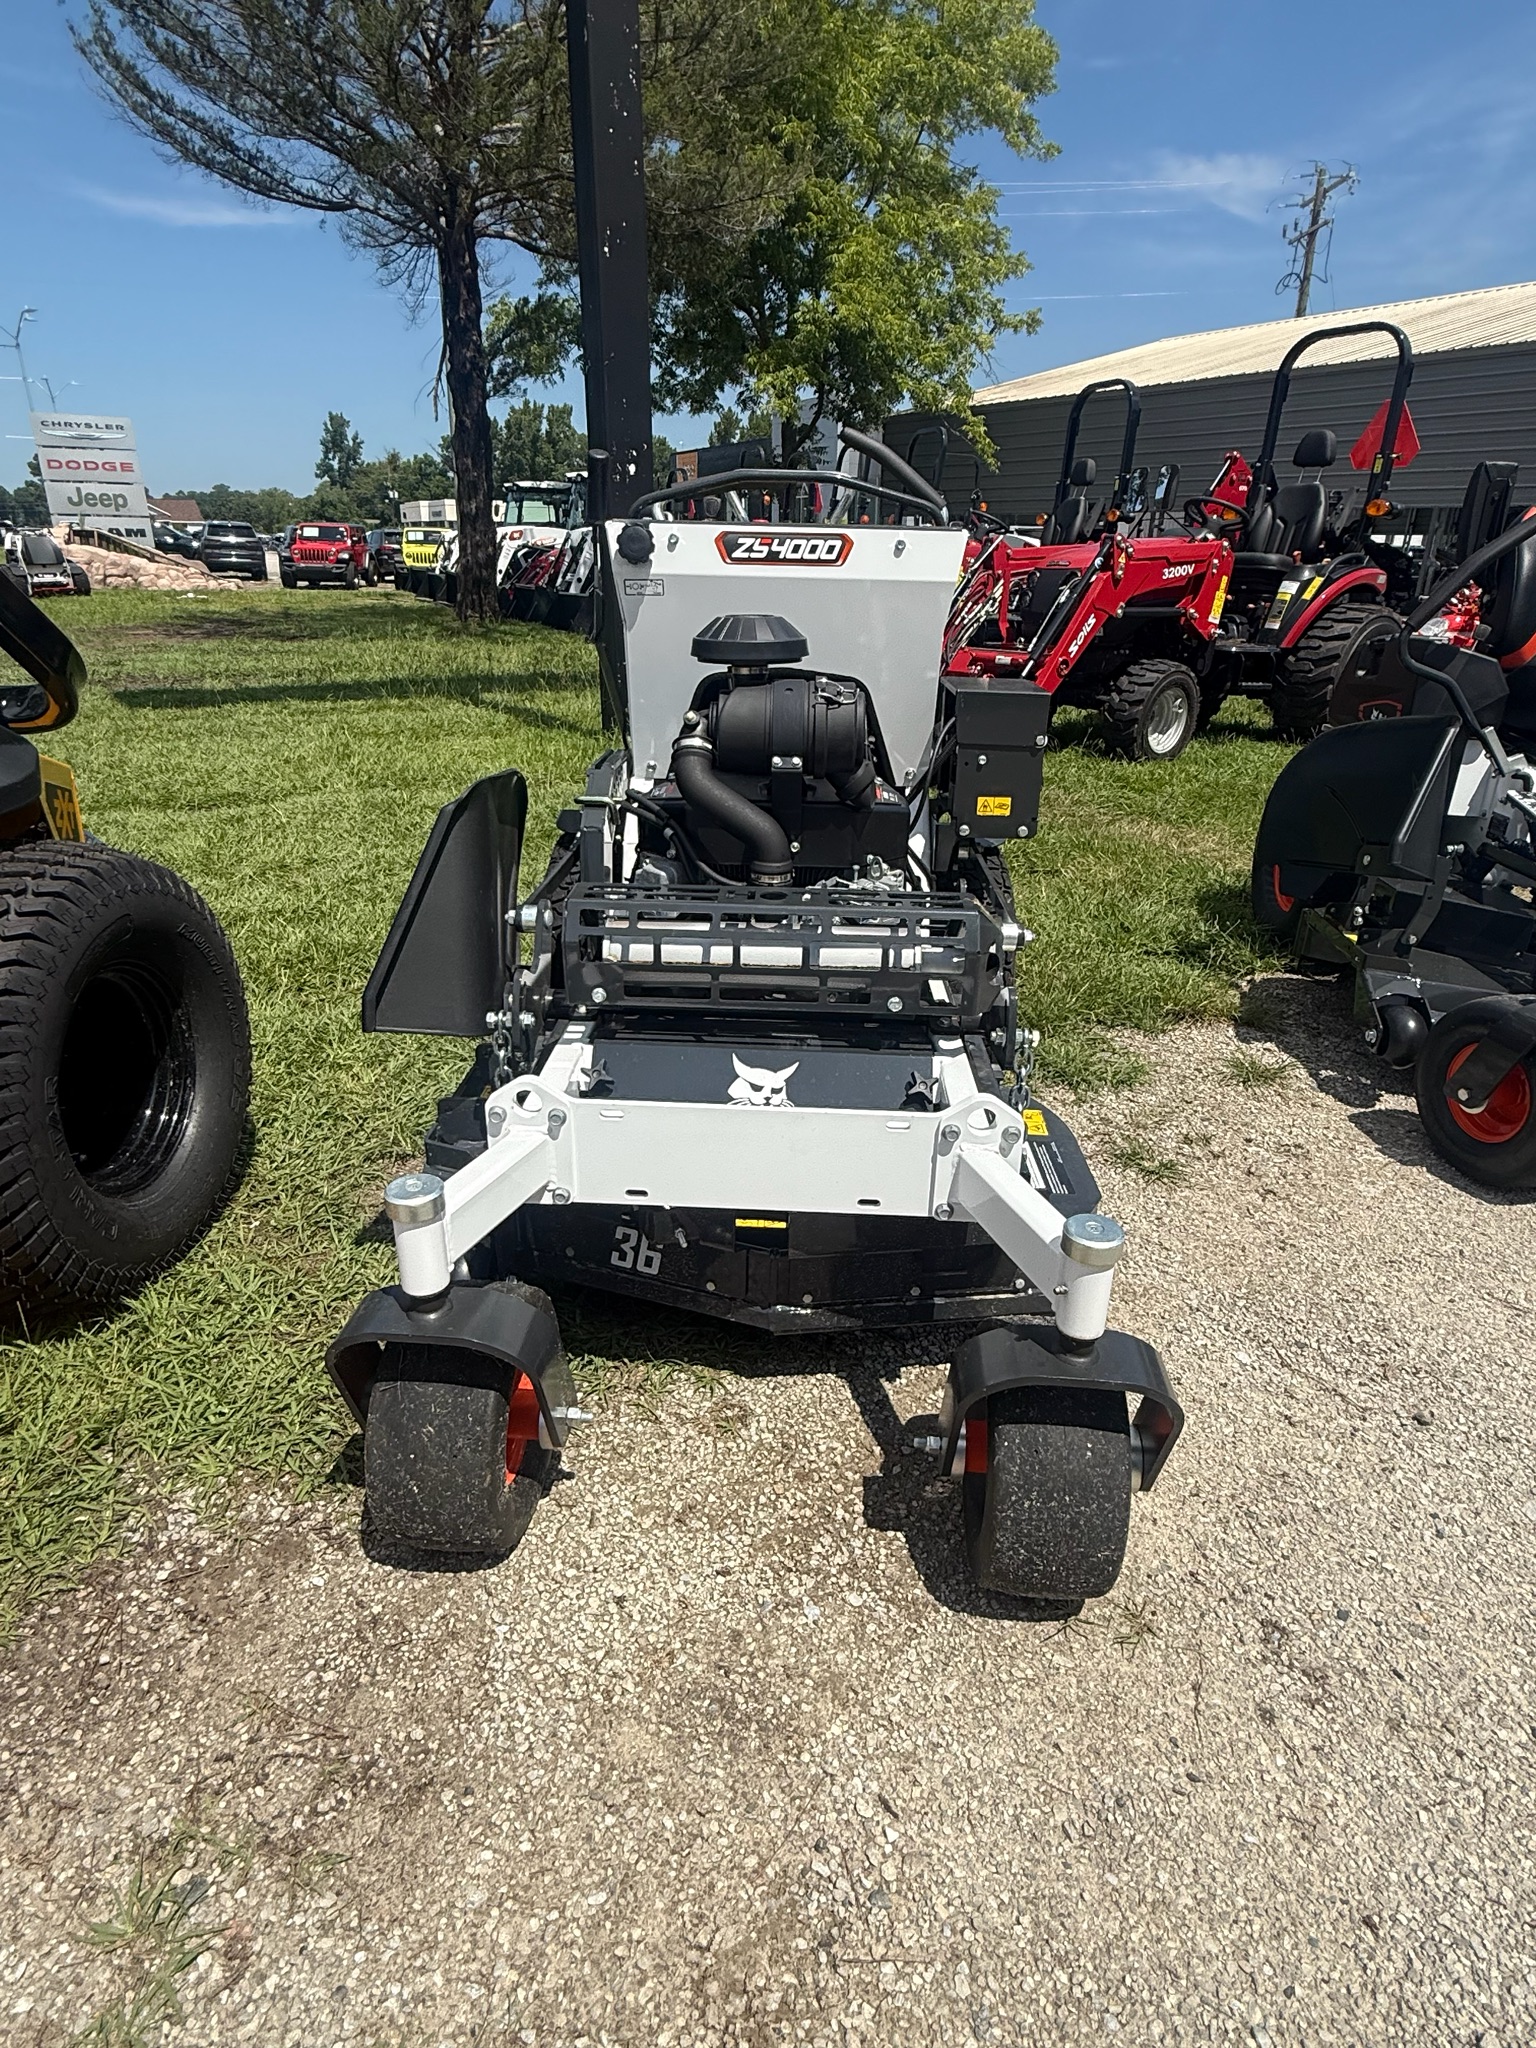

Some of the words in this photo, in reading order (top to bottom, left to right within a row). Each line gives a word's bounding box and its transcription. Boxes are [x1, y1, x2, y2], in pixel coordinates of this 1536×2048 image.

[40, 420, 125, 431] CHRYSLER
[46, 459, 135, 472] DODGE
[67, 486, 128, 512] Jeep
[107, 527, 147, 538] AM
[731, 537, 843, 560] ZS4000
[1162, 564, 1196, 580] 3200V
[610, 1225, 662, 1275] 36
